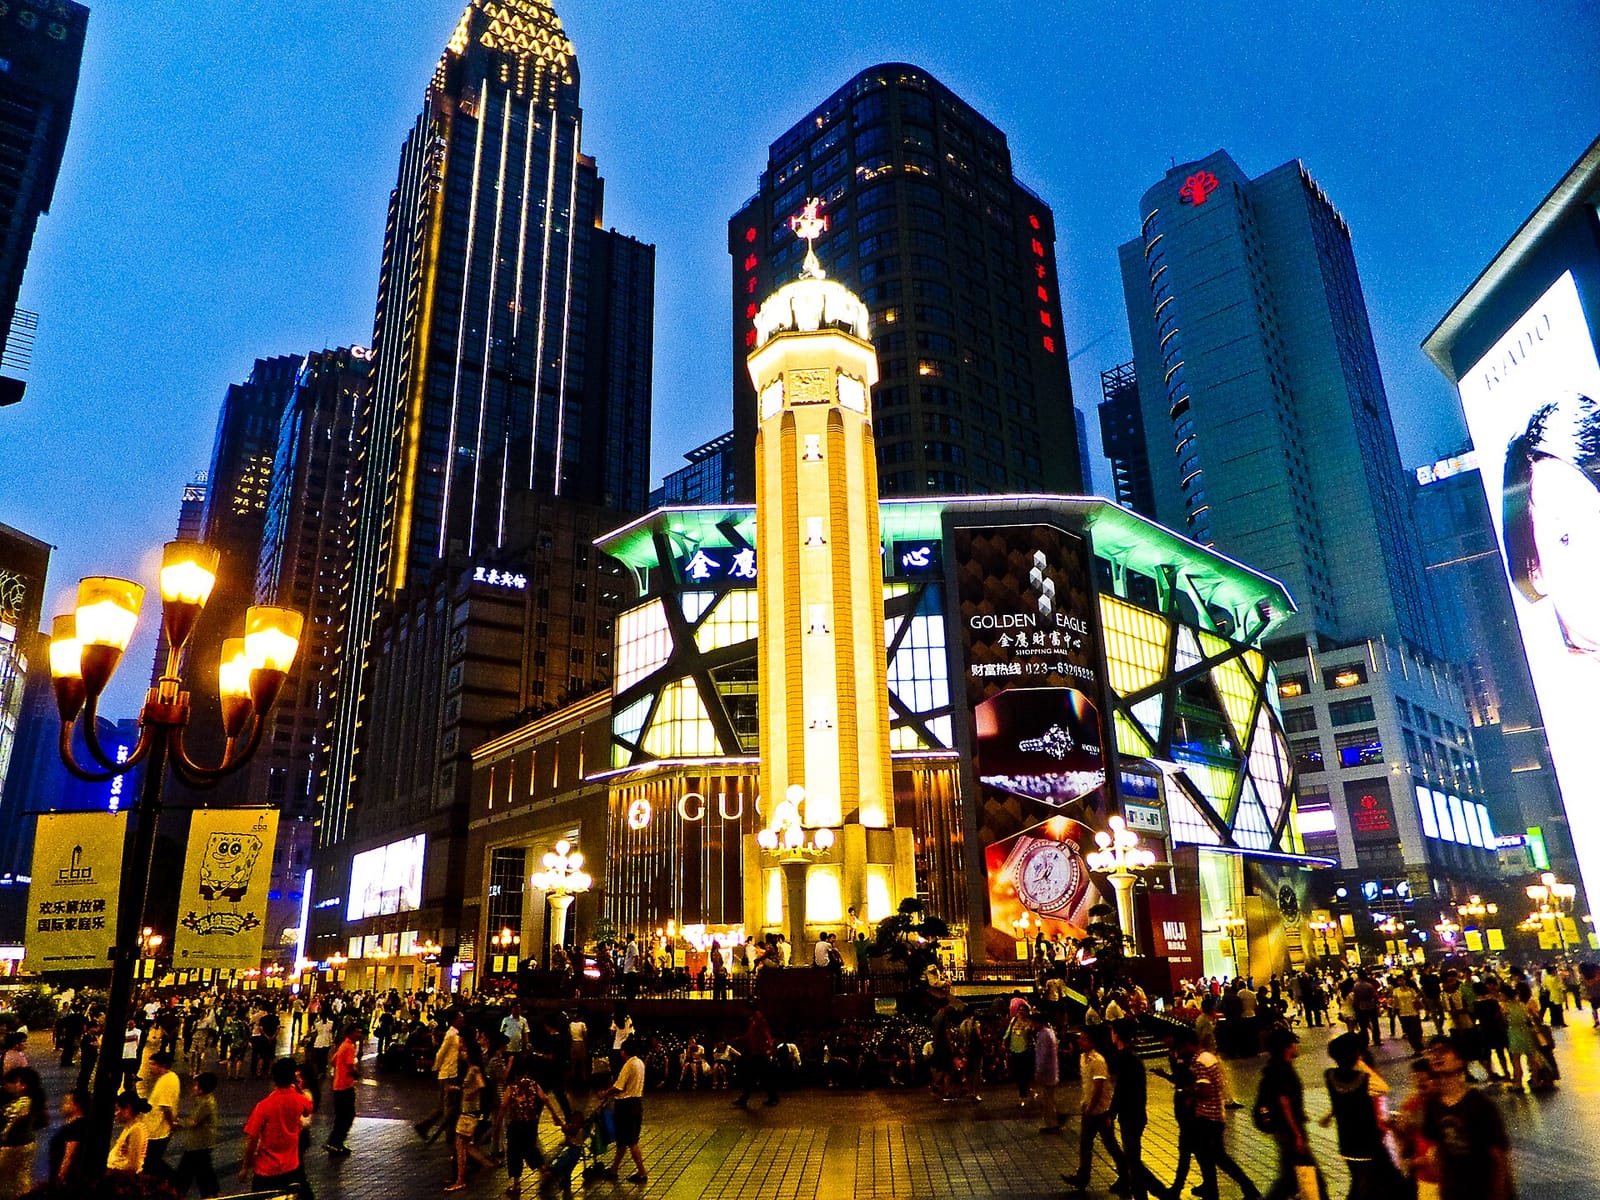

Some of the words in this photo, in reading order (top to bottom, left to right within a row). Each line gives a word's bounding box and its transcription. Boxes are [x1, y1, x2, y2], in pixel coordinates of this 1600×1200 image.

[685, 547, 758, 579] 金鹰
[902, 546, 931, 567] 心
[970, 613, 1037, 629] GOLDEN
[1055, 612, 1088, 635] EAGLE
[997, 630, 1081, 649] 金鹰财富中心
[1015, 648, 1052, 656] SHOPPING
[1053, 647, 1068, 656] MALL
[971, 662, 1022, 677] 财富热线
[678, 792, 761, 821] GU
[37, 916, 105, 932] 国际家庭乐
[1162, 921, 1187, 941] MUJI
